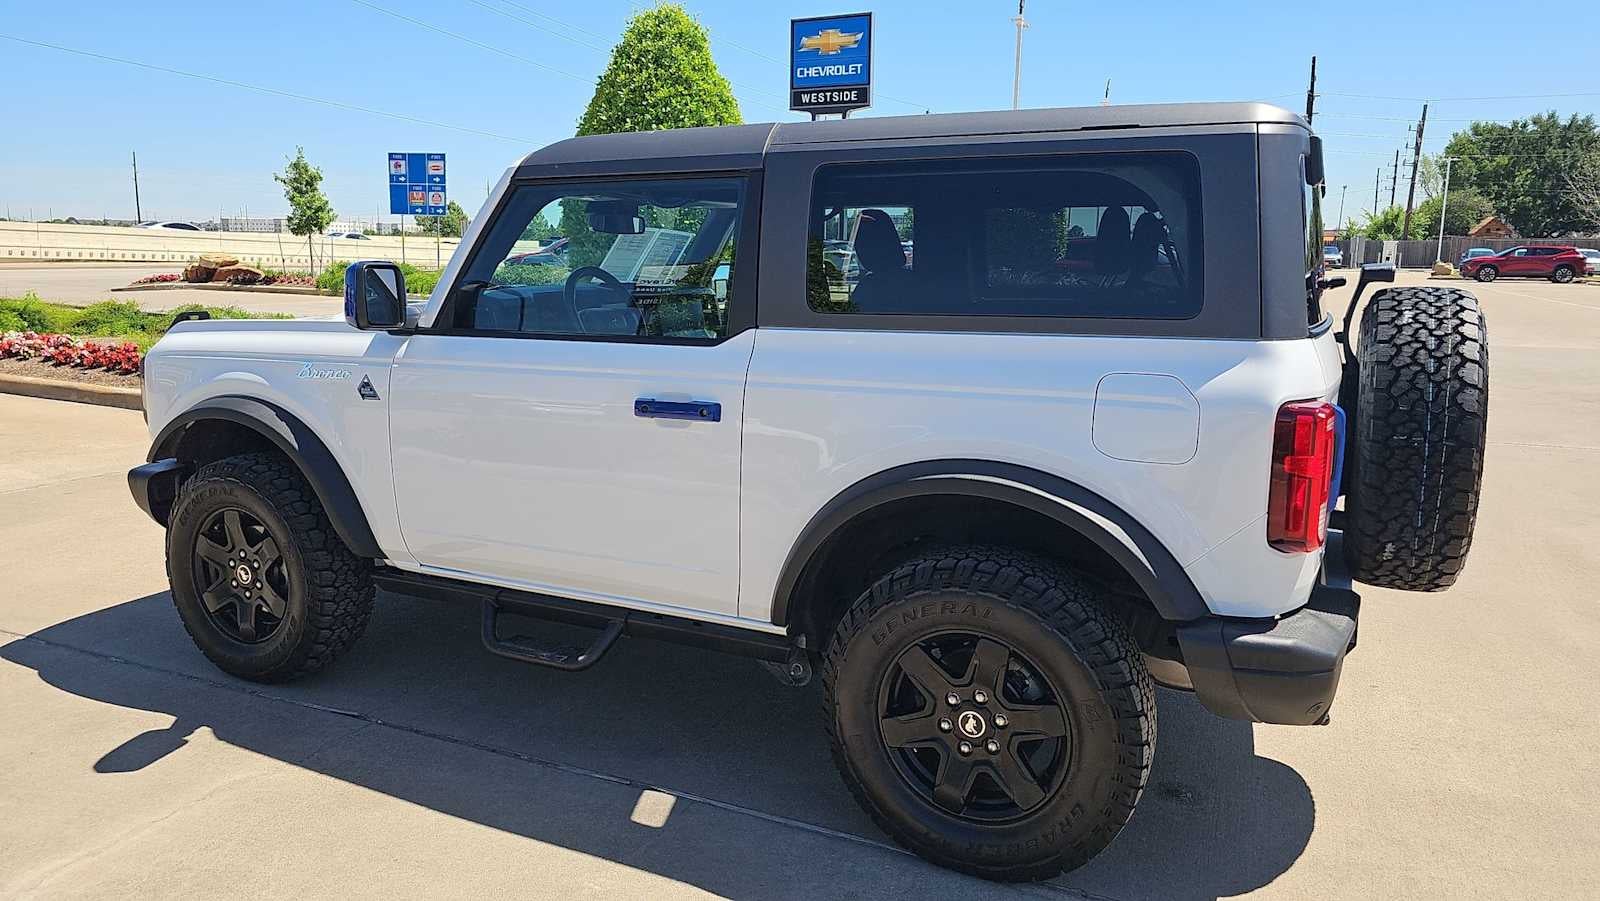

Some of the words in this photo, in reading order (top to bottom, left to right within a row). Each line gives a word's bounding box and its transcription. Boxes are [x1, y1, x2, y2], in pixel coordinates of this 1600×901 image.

[797, 64, 863, 78] CHEVROLET
[801, 91, 858, 103] WESTSIDE
[297, 361, 353, 380] Bronco
[872, 600, 993, 647] GENERAL
